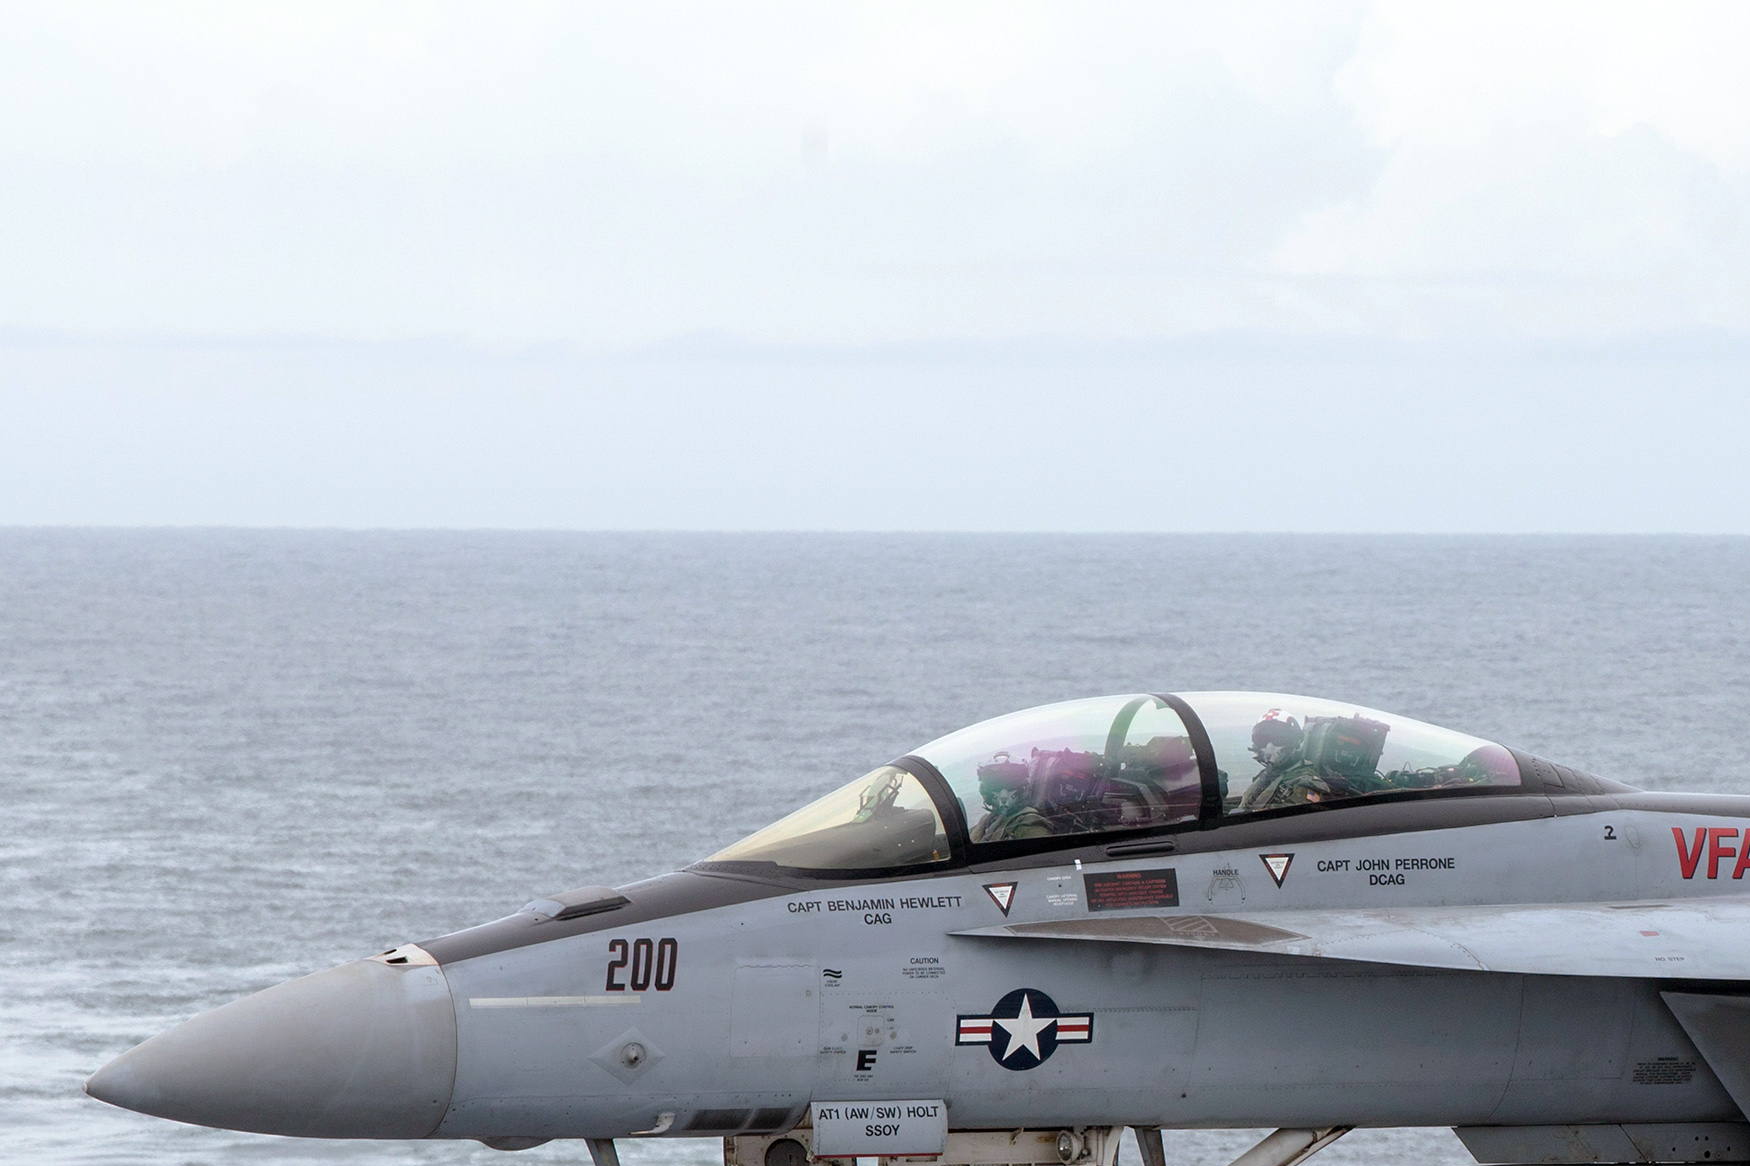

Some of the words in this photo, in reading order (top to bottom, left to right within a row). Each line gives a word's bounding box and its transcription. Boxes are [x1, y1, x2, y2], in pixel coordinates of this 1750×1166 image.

[1317, 860, 1350, 873] CAPT
[1355, 858, 1390, 871] JOHN
[1395, 857, 1456, 870] PERRONE
[1212, 868, 1240, 876] HANDLE
[1369, 873, 1405, 886] DCAG
[787, 901, 822, 913] CAPT
[827, 898, 895, 912] BENJAMIN
[900, 896, 962, 909] HEWLETT
[864, 913, 892, 925] CAG
[605, 937, 678, 992] 200
[910, 957, 939, 965] CAUTION
[856, 1049, 878, 1071] E
[819, 1108, 840, 1120] AT1
[906, 1106, 939, 1118] HOLT
[865, 1124, 901, 1137] SSOY
